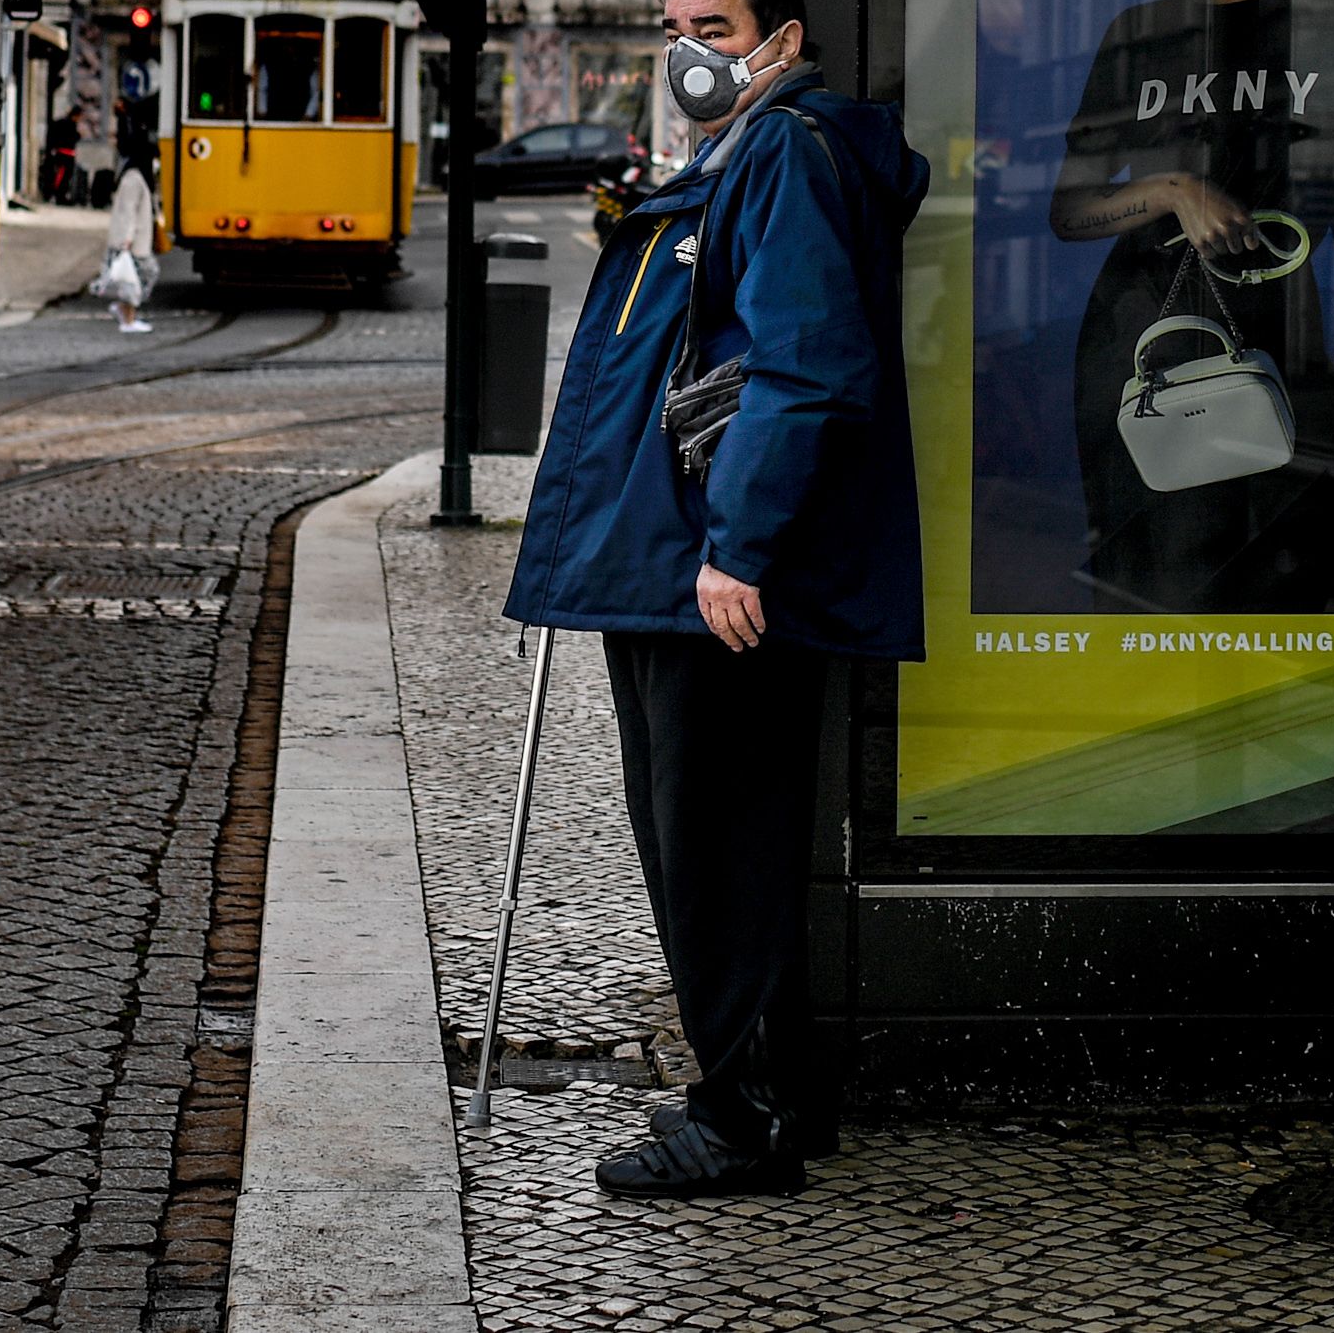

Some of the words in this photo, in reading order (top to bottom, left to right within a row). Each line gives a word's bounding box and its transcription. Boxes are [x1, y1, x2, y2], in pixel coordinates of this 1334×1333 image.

[1136, 69, 1321, 122] DKNY
[975, 632, 1092, 654] HALSEY
[1121, 632, 1334, 654] #DKNYCALLING
